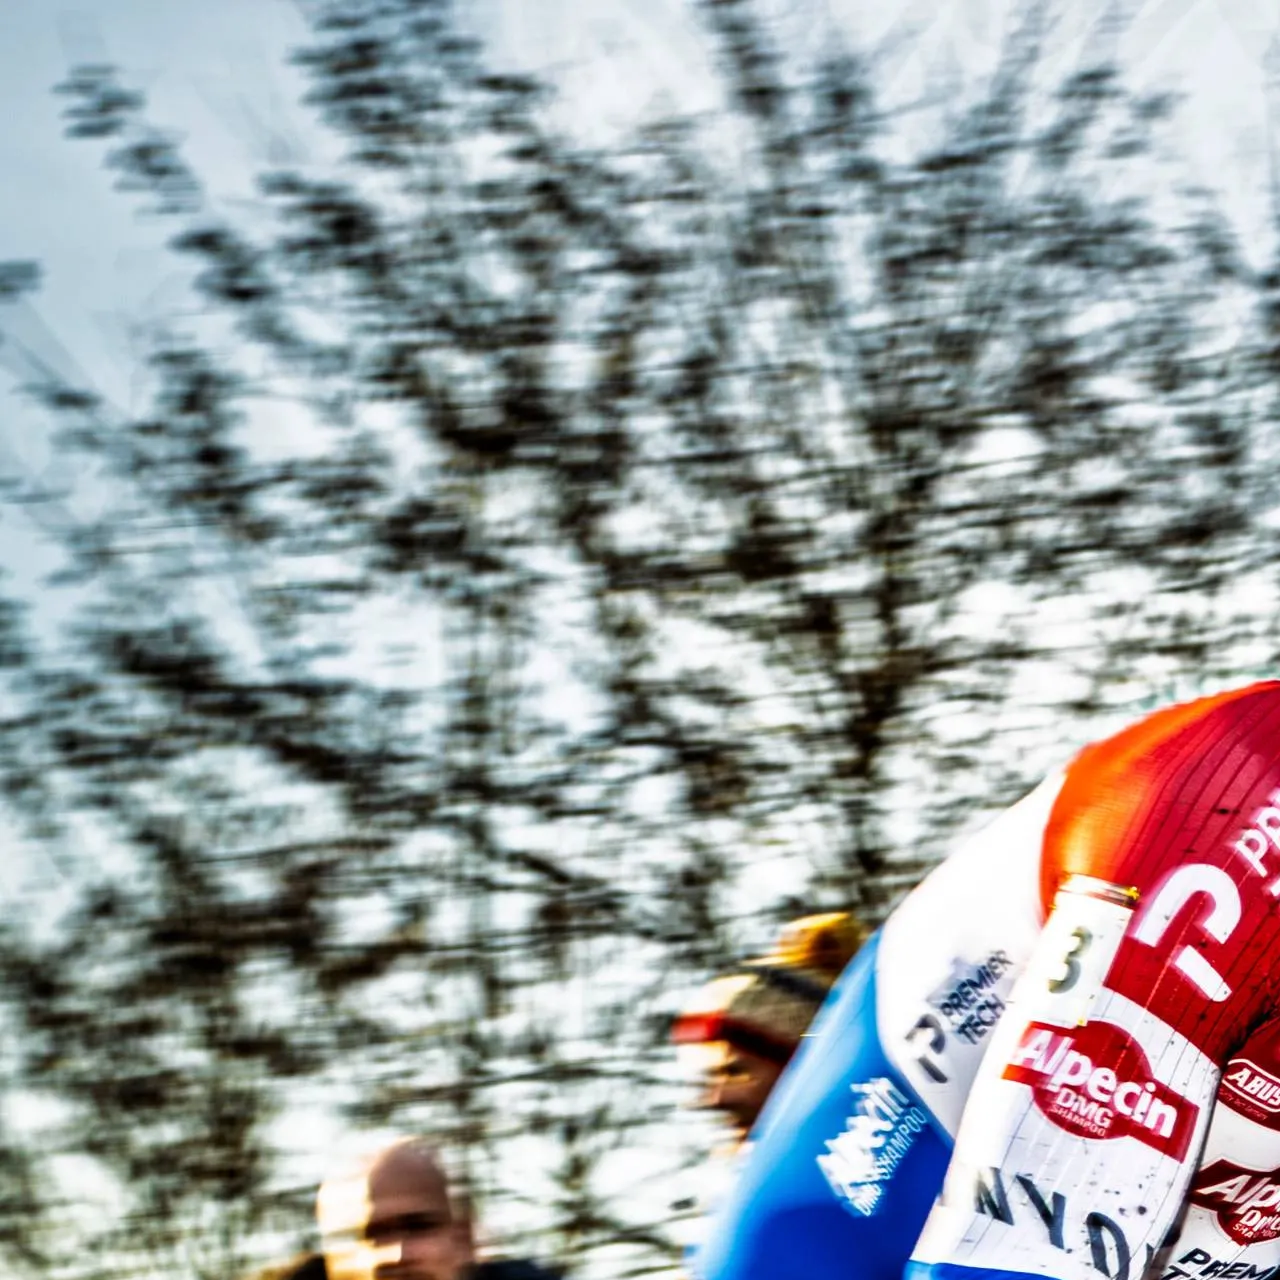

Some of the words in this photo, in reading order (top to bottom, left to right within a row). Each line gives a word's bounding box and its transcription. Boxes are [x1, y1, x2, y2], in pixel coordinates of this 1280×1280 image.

[1047, 925, 1093, 994] 3
[1015, 1031, 1180, 1139] Alpecin
[1054, 1086, 1114, 1129] DMG
